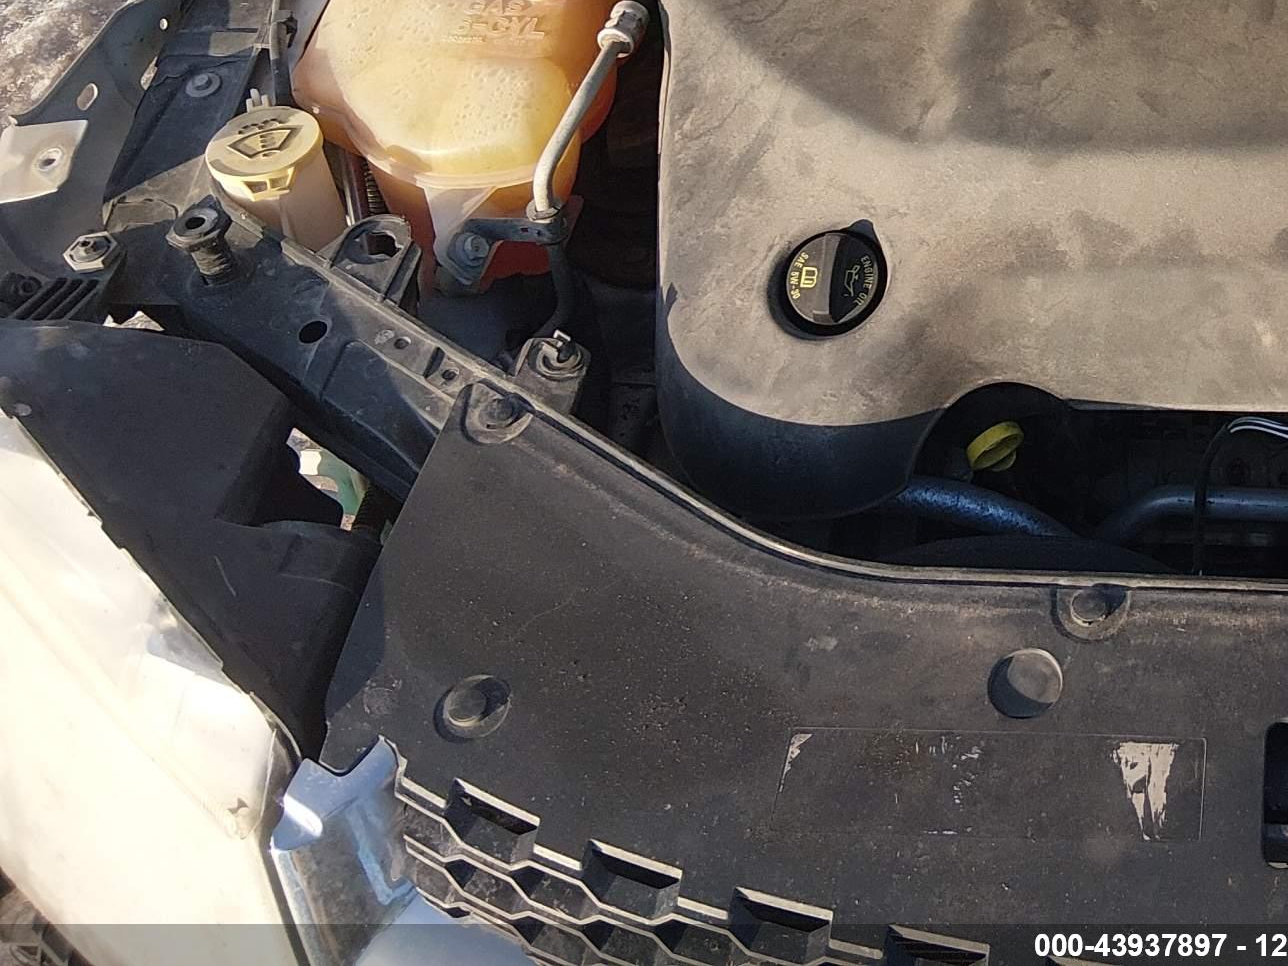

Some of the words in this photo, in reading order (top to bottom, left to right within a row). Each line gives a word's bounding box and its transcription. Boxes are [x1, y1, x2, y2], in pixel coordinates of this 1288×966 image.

[794, 252, 809, 268] SAE
[861, 255, 875, 290] ENGINE
[790, 271, 801, 299] 5W-30
[853, 292, 868, 306] OIL
